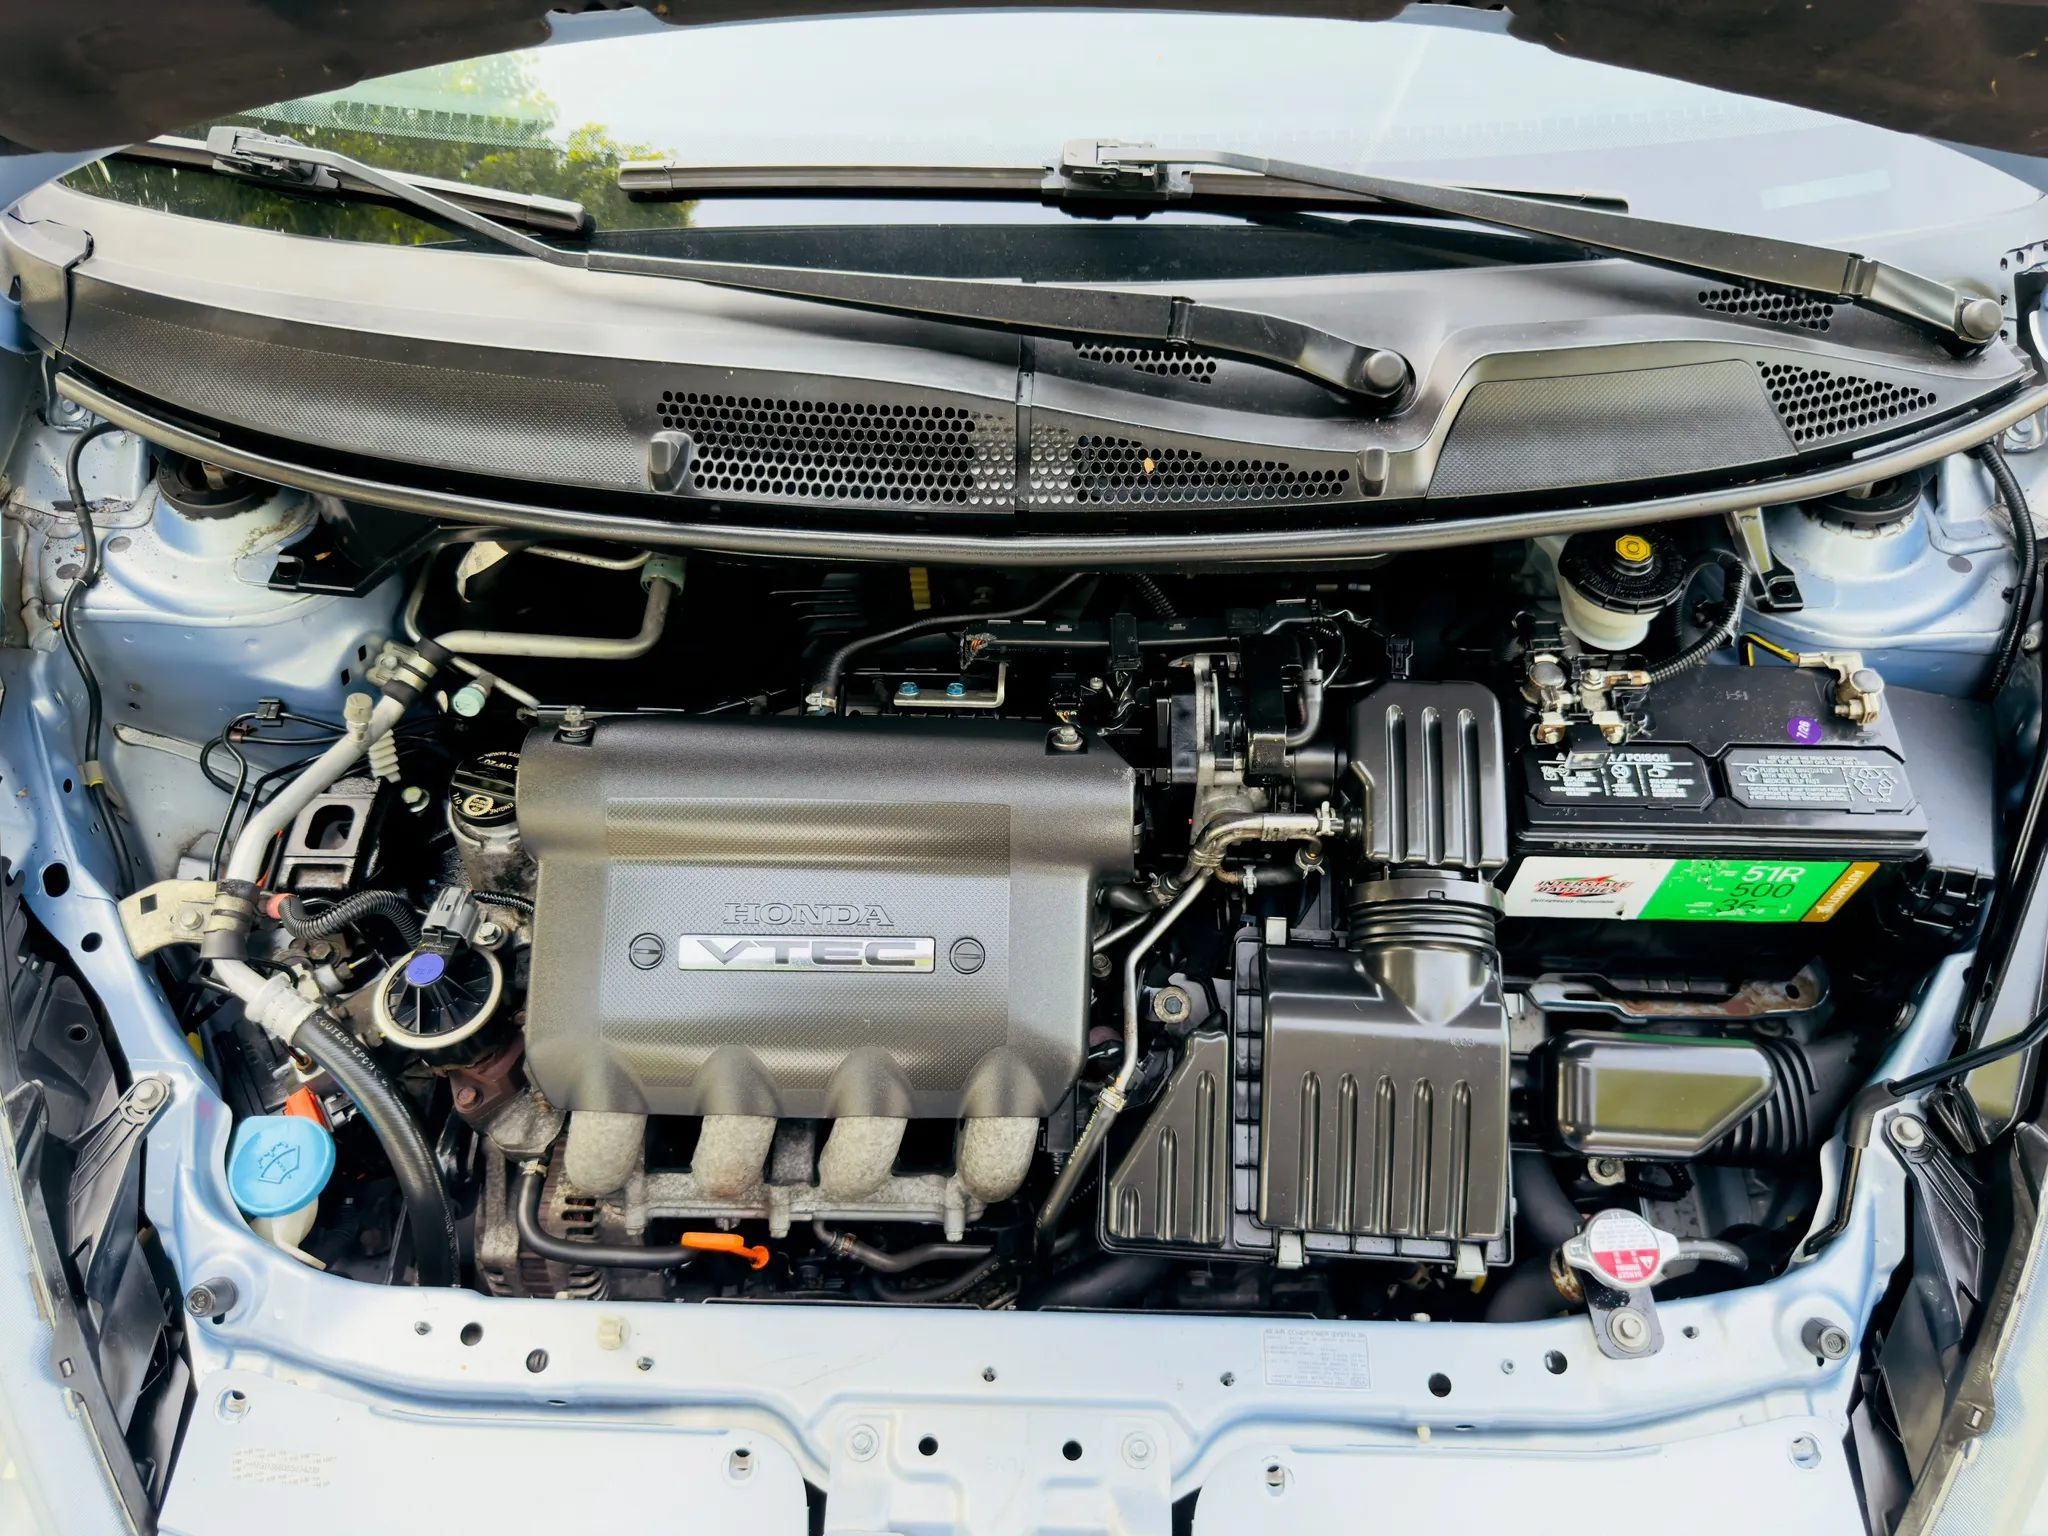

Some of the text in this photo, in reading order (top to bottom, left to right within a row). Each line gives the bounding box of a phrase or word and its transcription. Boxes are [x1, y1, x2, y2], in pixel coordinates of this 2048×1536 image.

[1626, 753, 1670, 762] POISON
[489, 802, 515, 815] ENGINE
[1742, 866, 1806, 883] 51R
[1538, 880, 1629, 888] INTERSTATE
[1730, 883, 1795, 899] 500
[723, 902, 894, 927] HONDA
[697, 939, 918, 967] VTEC
